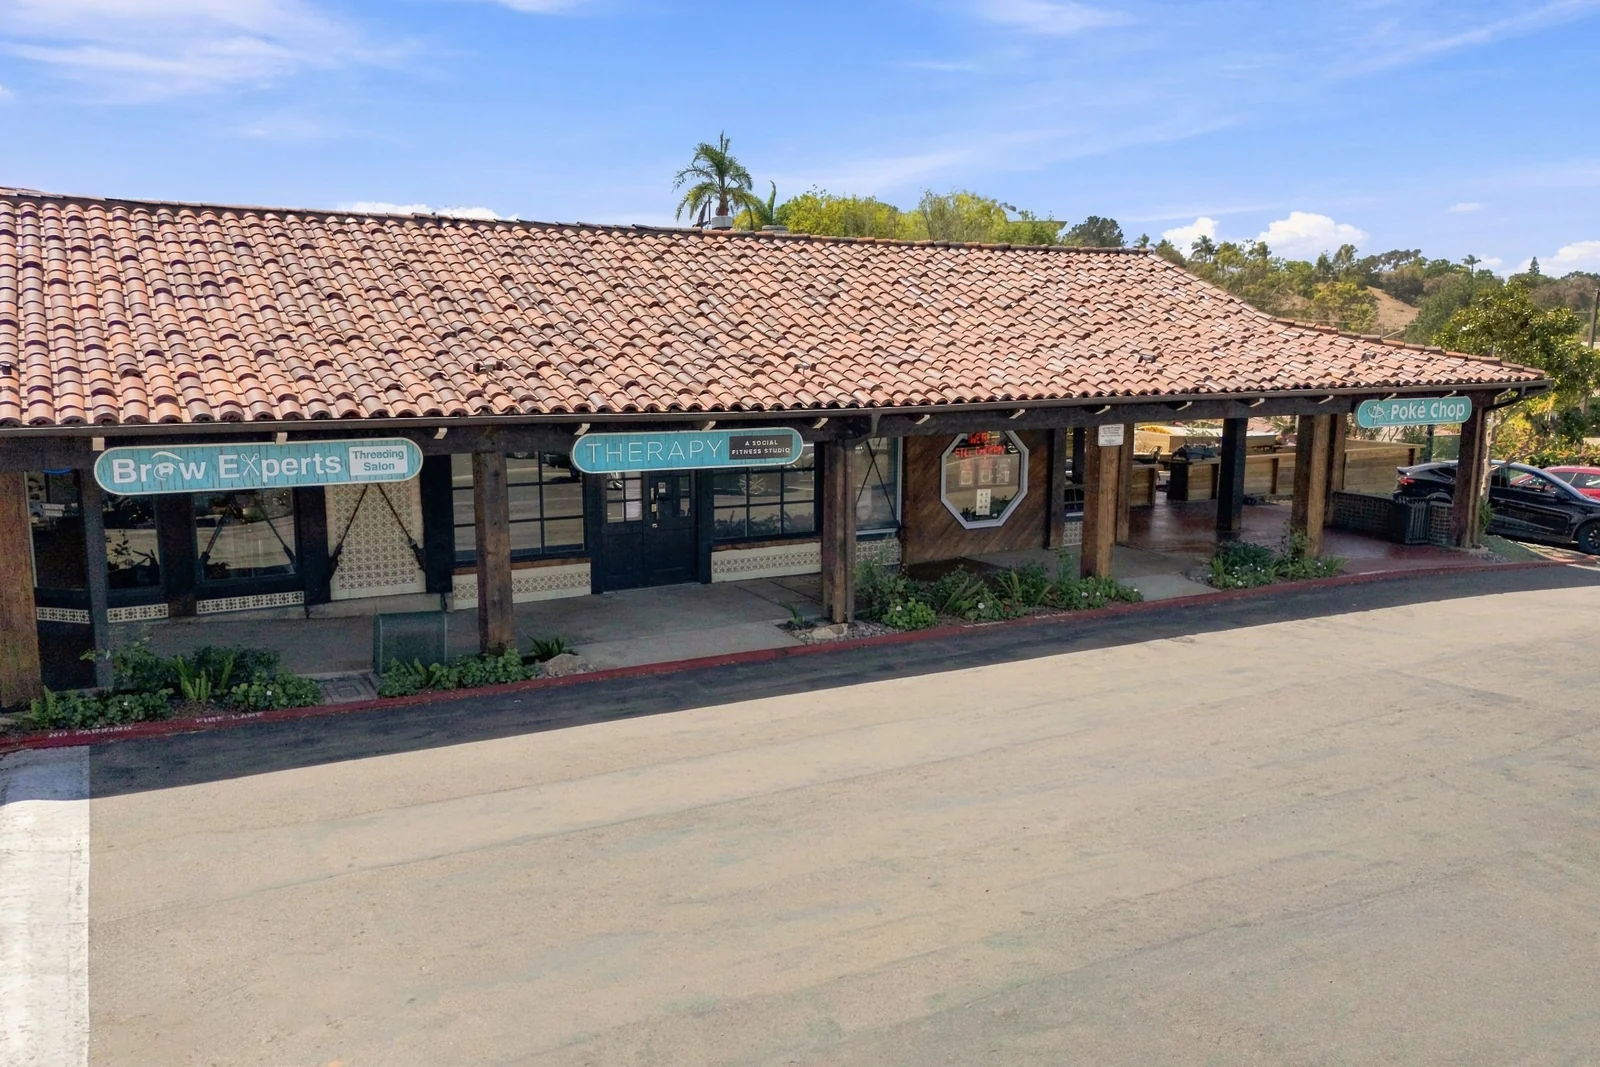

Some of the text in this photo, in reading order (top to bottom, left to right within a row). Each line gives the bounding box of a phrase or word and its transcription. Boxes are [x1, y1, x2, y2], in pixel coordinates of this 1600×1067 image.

[1391, 401, 1465, 420] Poké Chop
[352, 449, 405, 460] Threading
[586, 439, 723, 464] THERAPY
[363, 462, 395, 471] Salon
